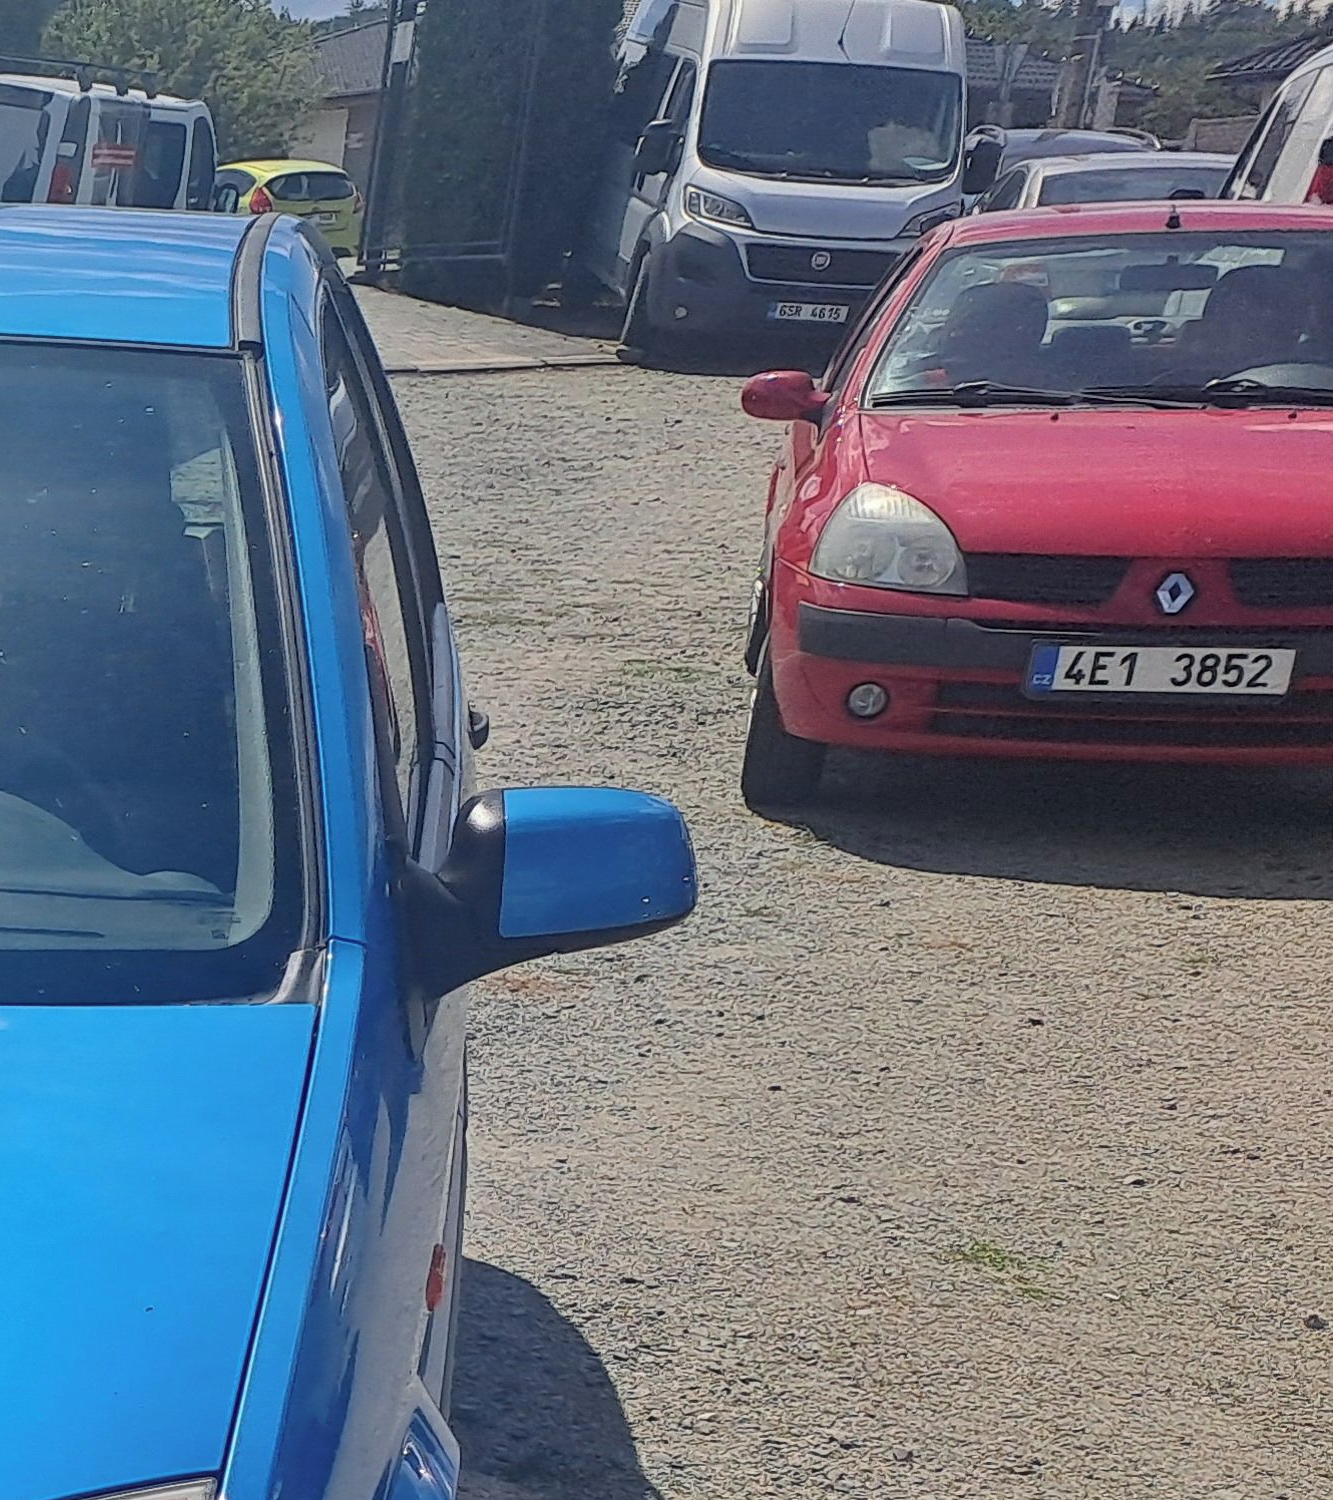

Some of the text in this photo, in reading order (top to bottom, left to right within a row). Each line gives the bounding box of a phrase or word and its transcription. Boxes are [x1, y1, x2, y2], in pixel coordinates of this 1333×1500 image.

[1033, 651, 1273, 688] CZ 4E1 3852
